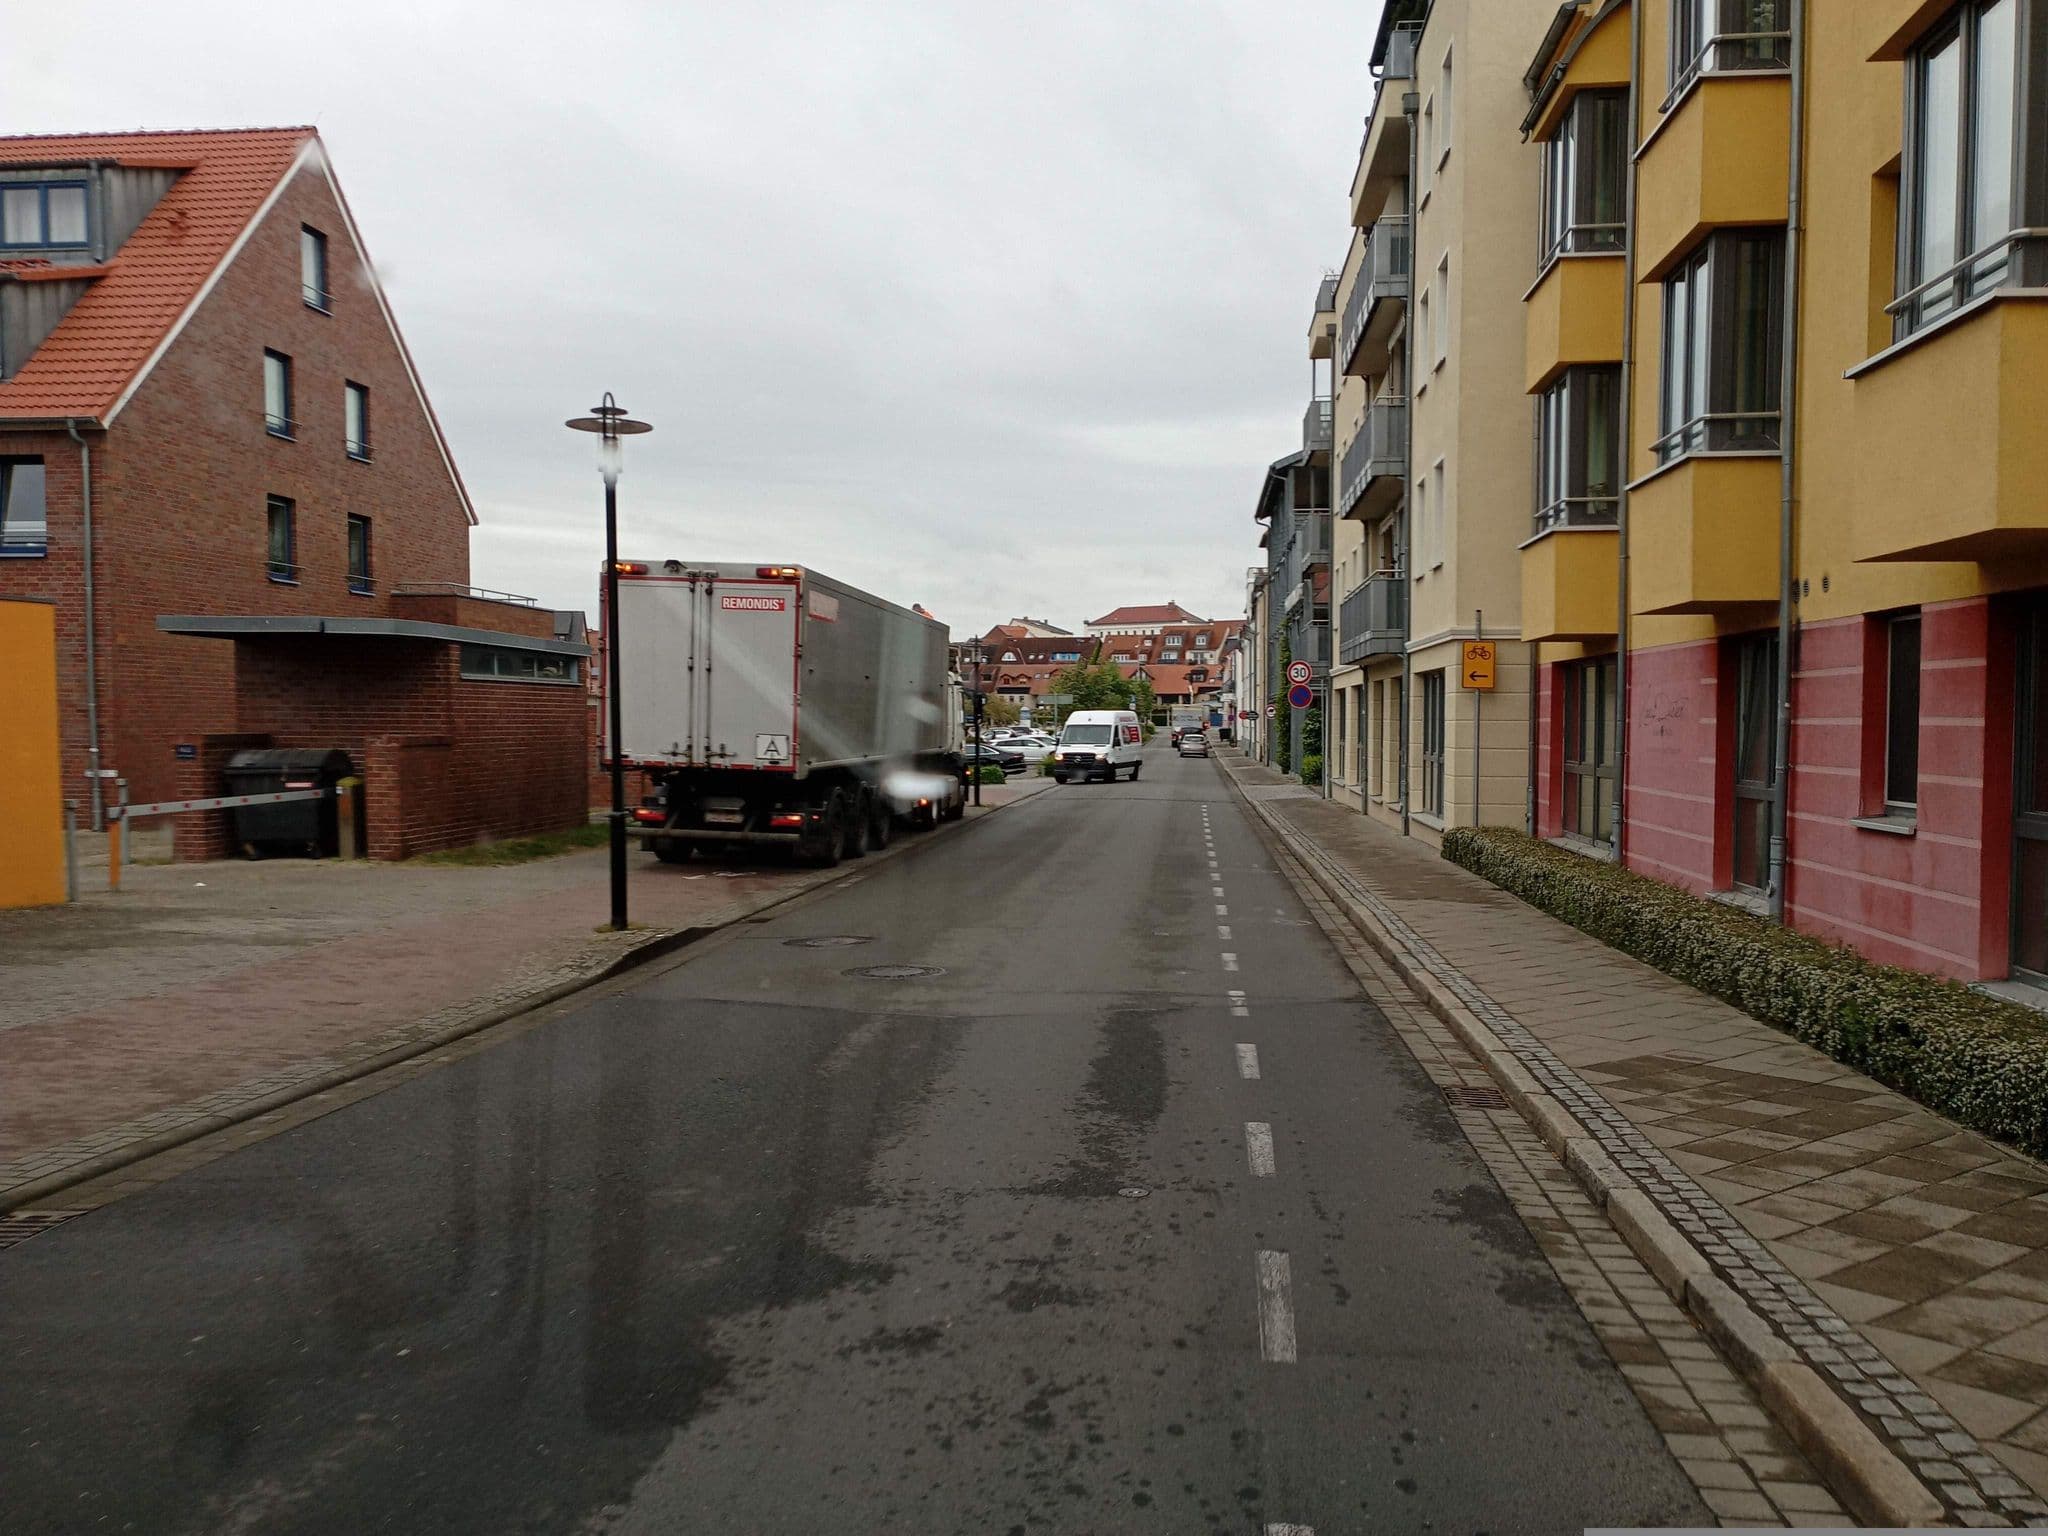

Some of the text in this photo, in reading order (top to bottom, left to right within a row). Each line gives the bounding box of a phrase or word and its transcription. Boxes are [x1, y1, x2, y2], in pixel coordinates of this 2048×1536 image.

[722, 597, 781, 610] REMONDIS
[1292, 667, 1307, 678] 30
[763, 738, 781, 756] A
